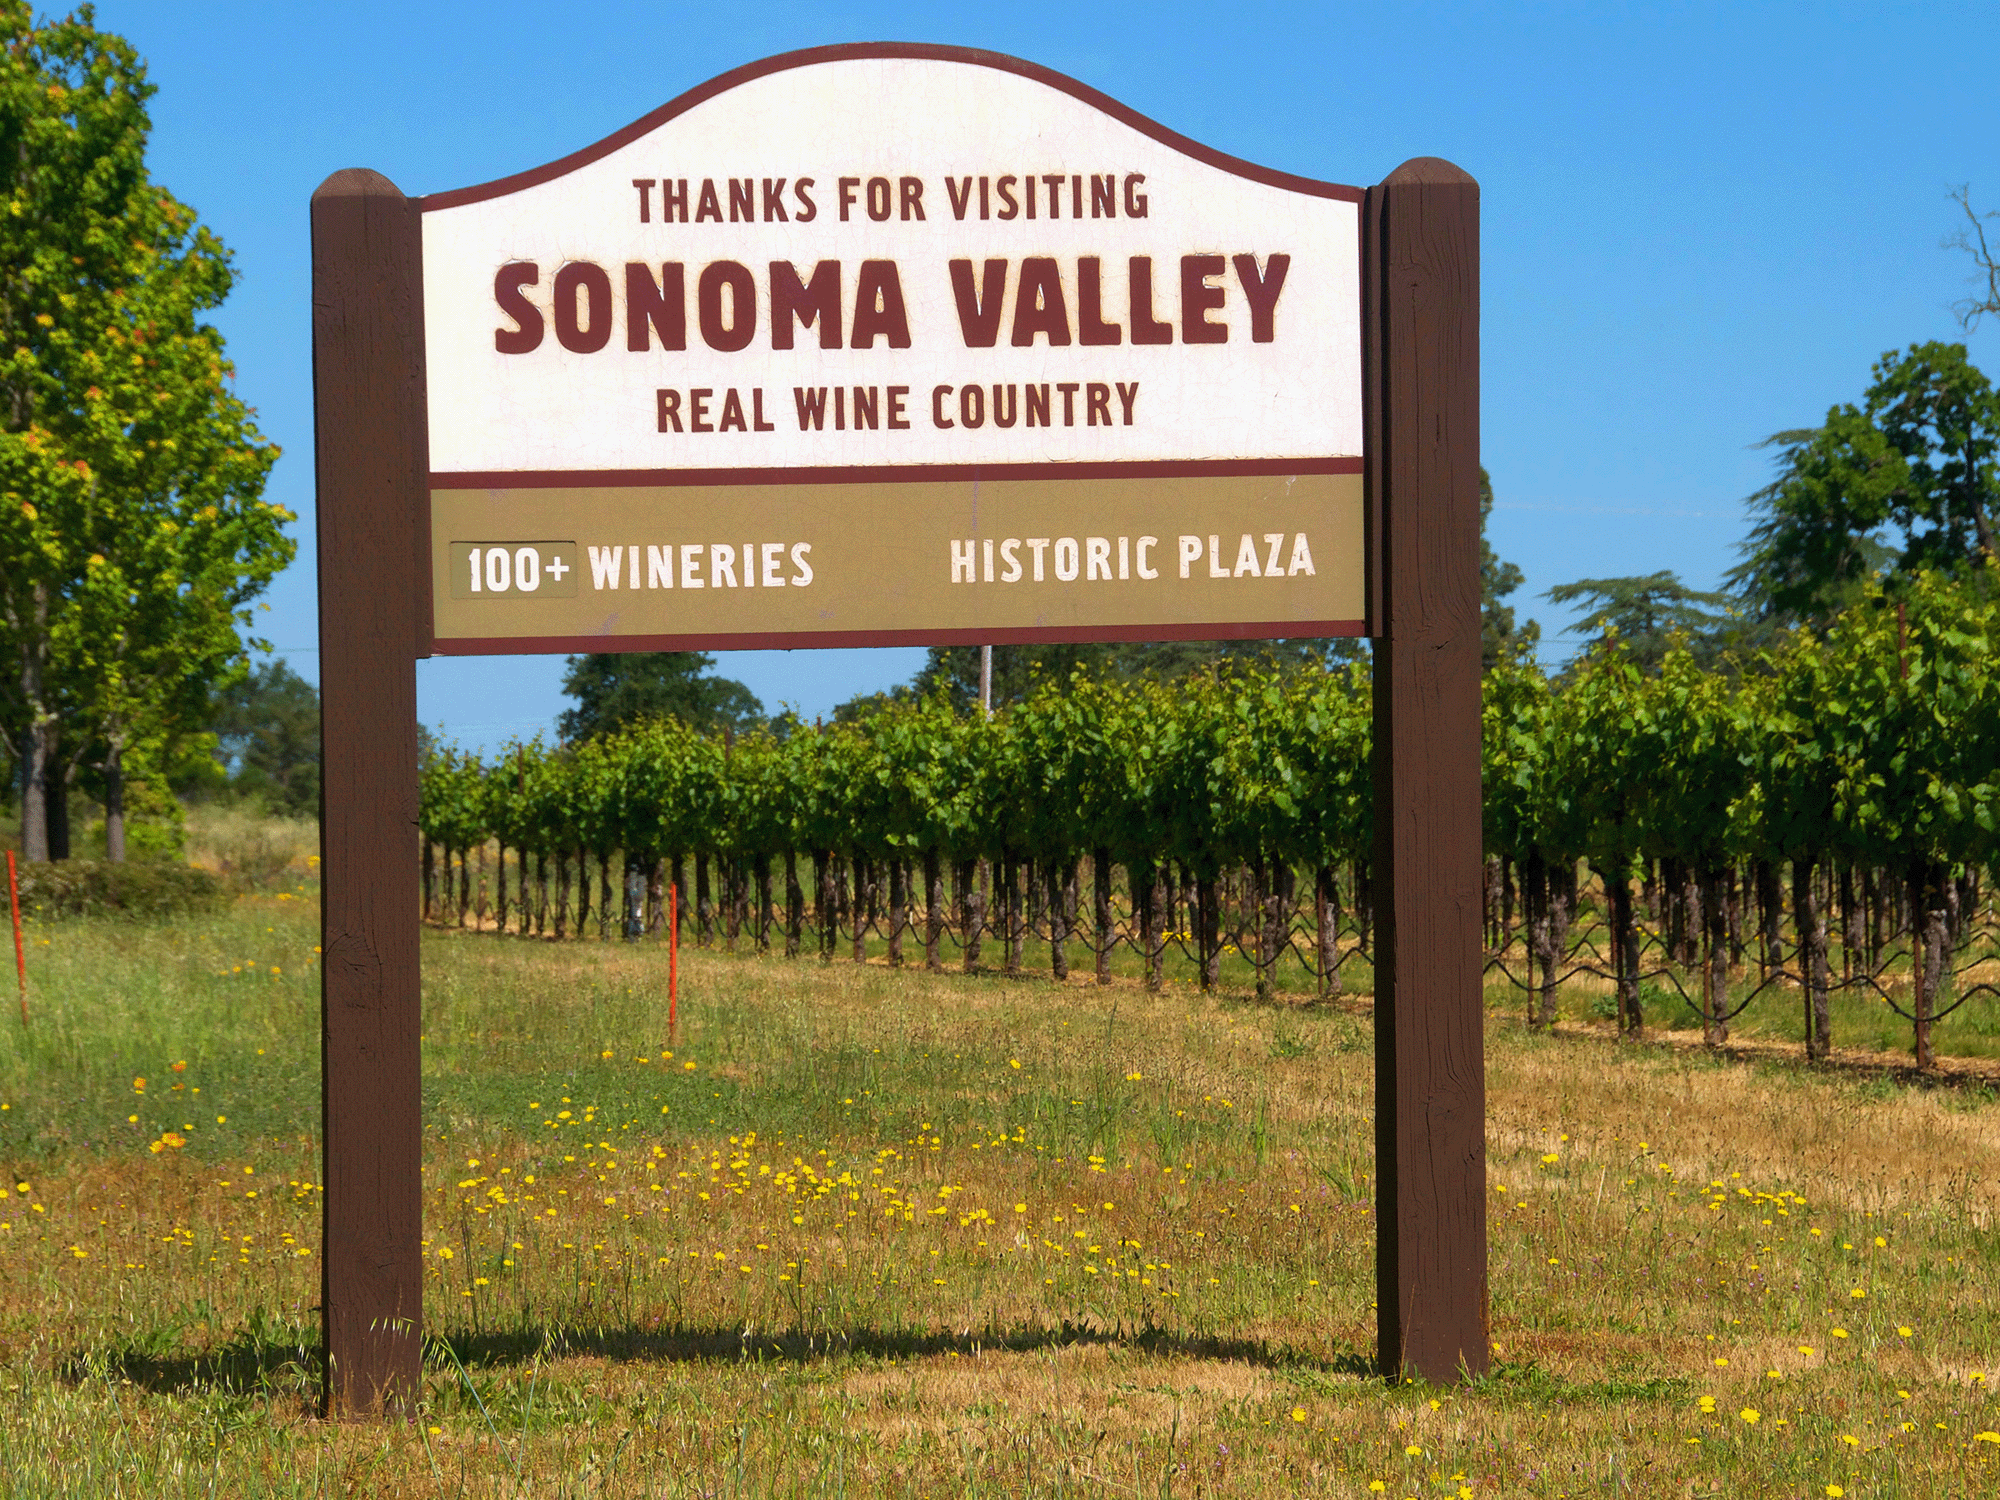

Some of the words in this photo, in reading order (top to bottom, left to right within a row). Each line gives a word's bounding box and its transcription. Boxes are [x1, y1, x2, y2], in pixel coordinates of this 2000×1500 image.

[633, 178, 816, 223] THANKS
[839, 177, 926, 221] FOR
[945, 173, 1147, 220] VISITING
[494, 260, 911, 354] SONOMA
[949, 253, 1290, 347] VALLEY
[657, 388, 774, 433] REAL
[793, 386, 910, 431] WINE
[933, 383, 1139, 429] COUNTRY
[469, 548, 569, 591] 100+
[588, 542, 813, 590] WINERIES
[951, 536, 1158, 582] HISTORIC
[1179, 533, 1315, 578] PLAZA
